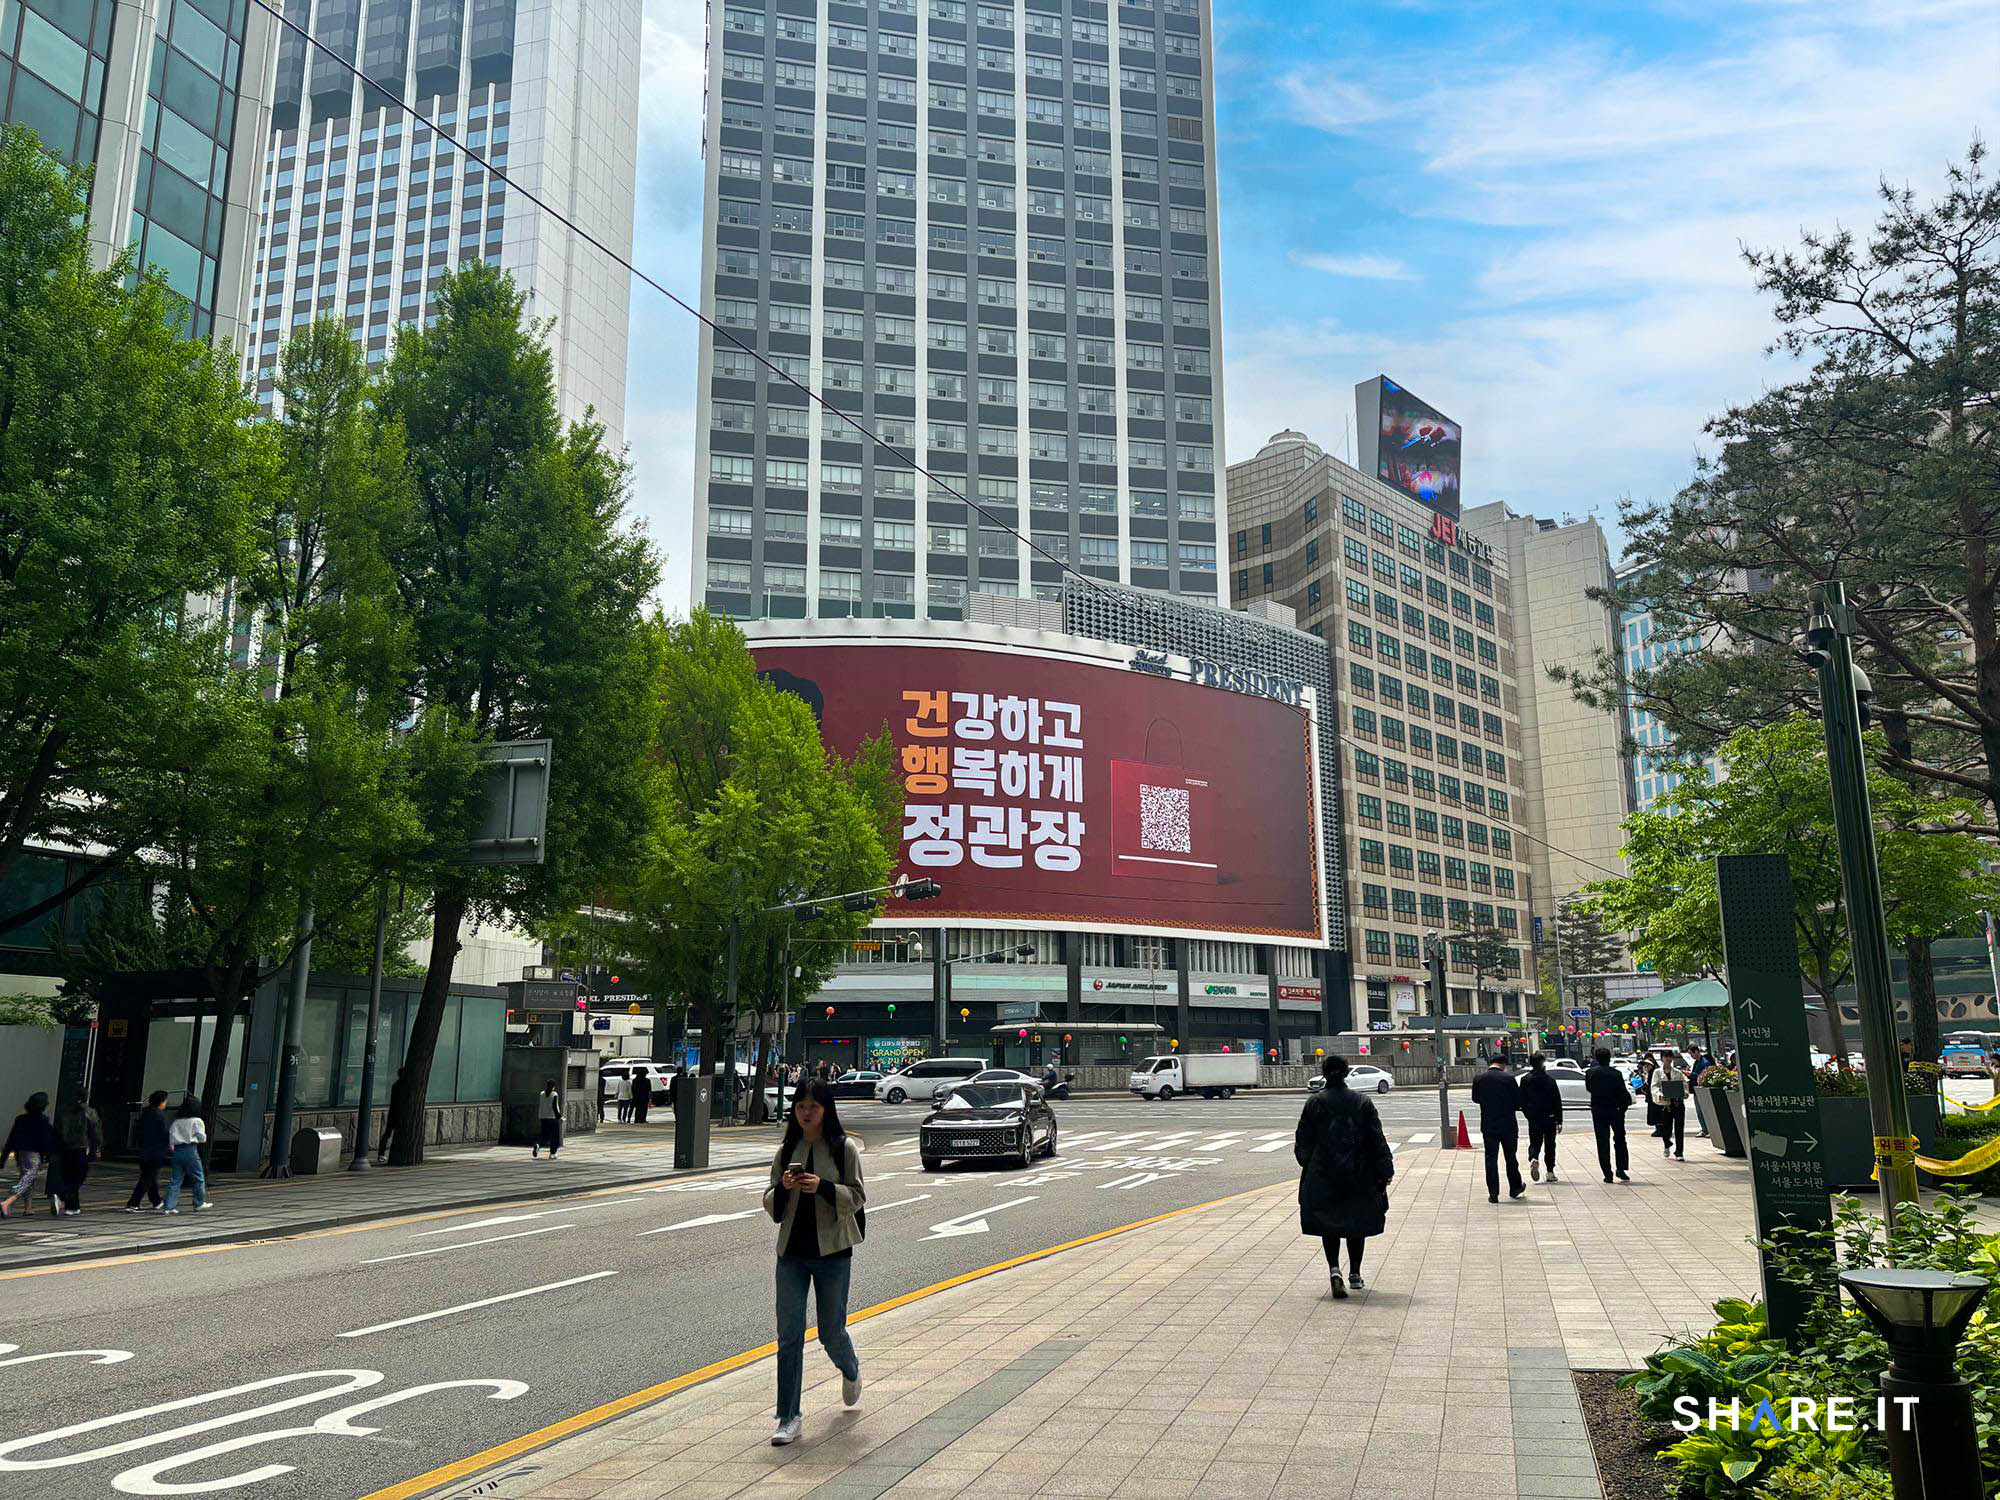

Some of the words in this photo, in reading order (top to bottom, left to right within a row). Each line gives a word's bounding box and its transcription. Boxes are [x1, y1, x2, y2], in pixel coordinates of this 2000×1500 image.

[1429, 512, 1456, 547] JEI
[1189, 656, 1304, 706] PRESIDENT
[902, 690, 1084, 749] 건강하고
[901, 744, 1084, 803] 행복하게
[903, 804, 1086, 872] 정관장
[1741, 1026, 1771, 1039] 시민청
[1760, 1160, 1823, 1173] 서울시청정문
[1771, 1176, 1824, 1189] 서울도서관
